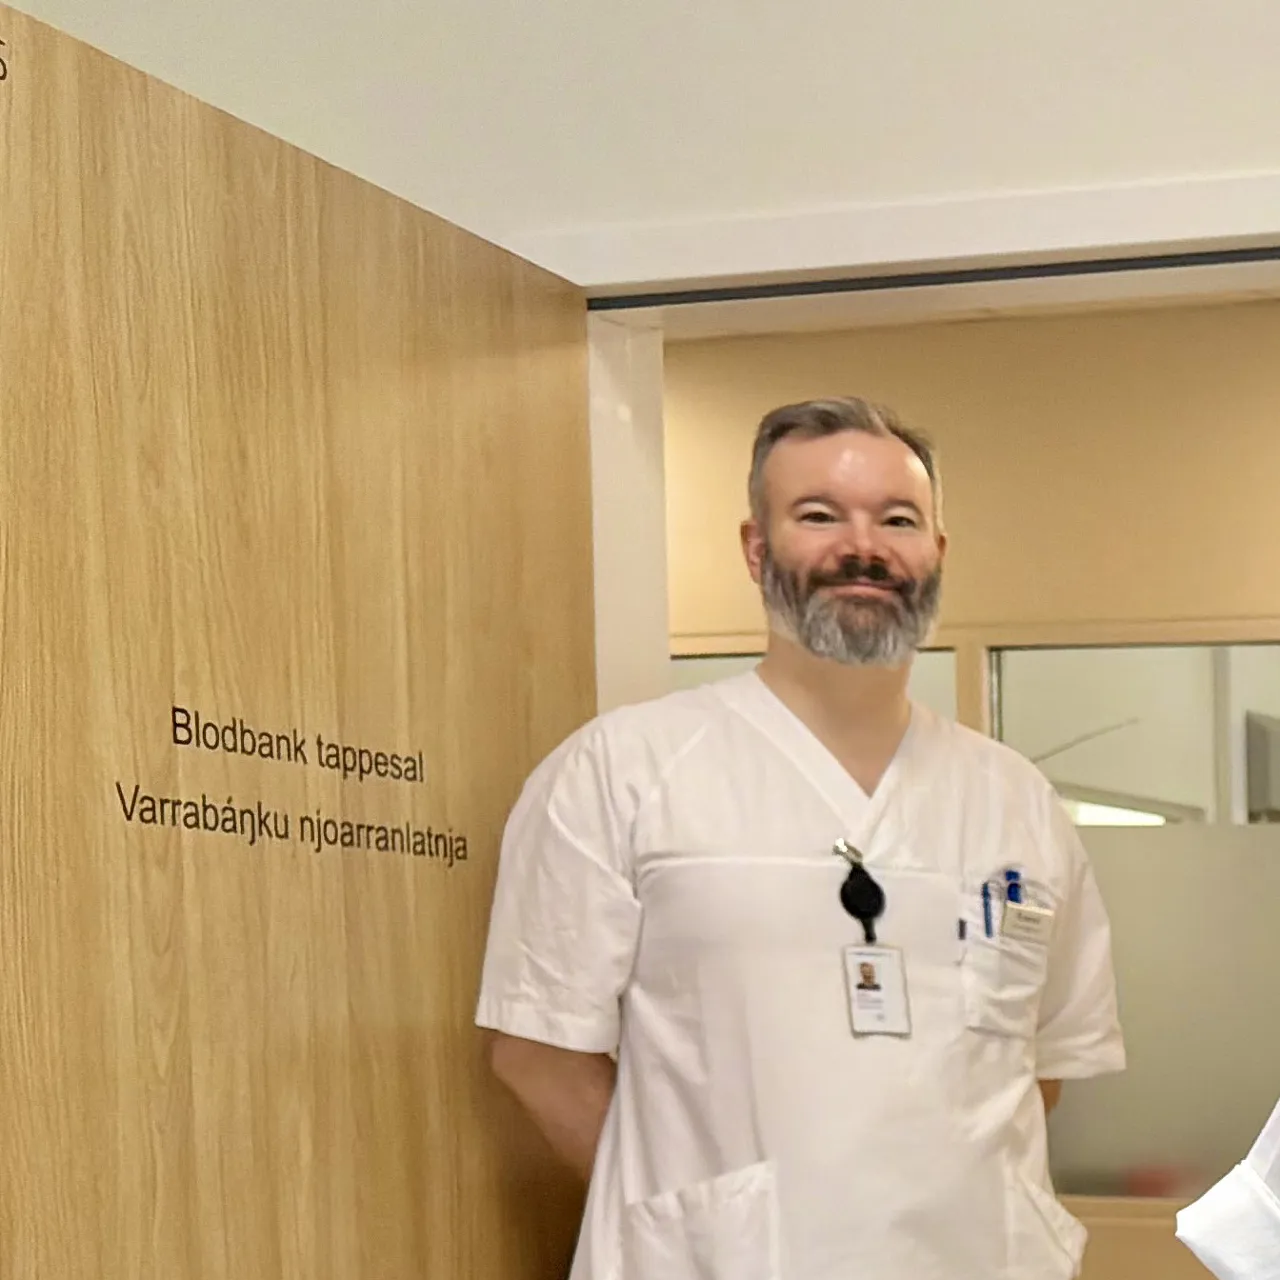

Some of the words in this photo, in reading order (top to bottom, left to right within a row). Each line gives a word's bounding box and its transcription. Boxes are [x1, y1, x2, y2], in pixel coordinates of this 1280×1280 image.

[171, 706, 308, 765] Blodbank
[316, 734, 424, 783] tappesal
[299, 809, 468, 868] njoarranlatnja
